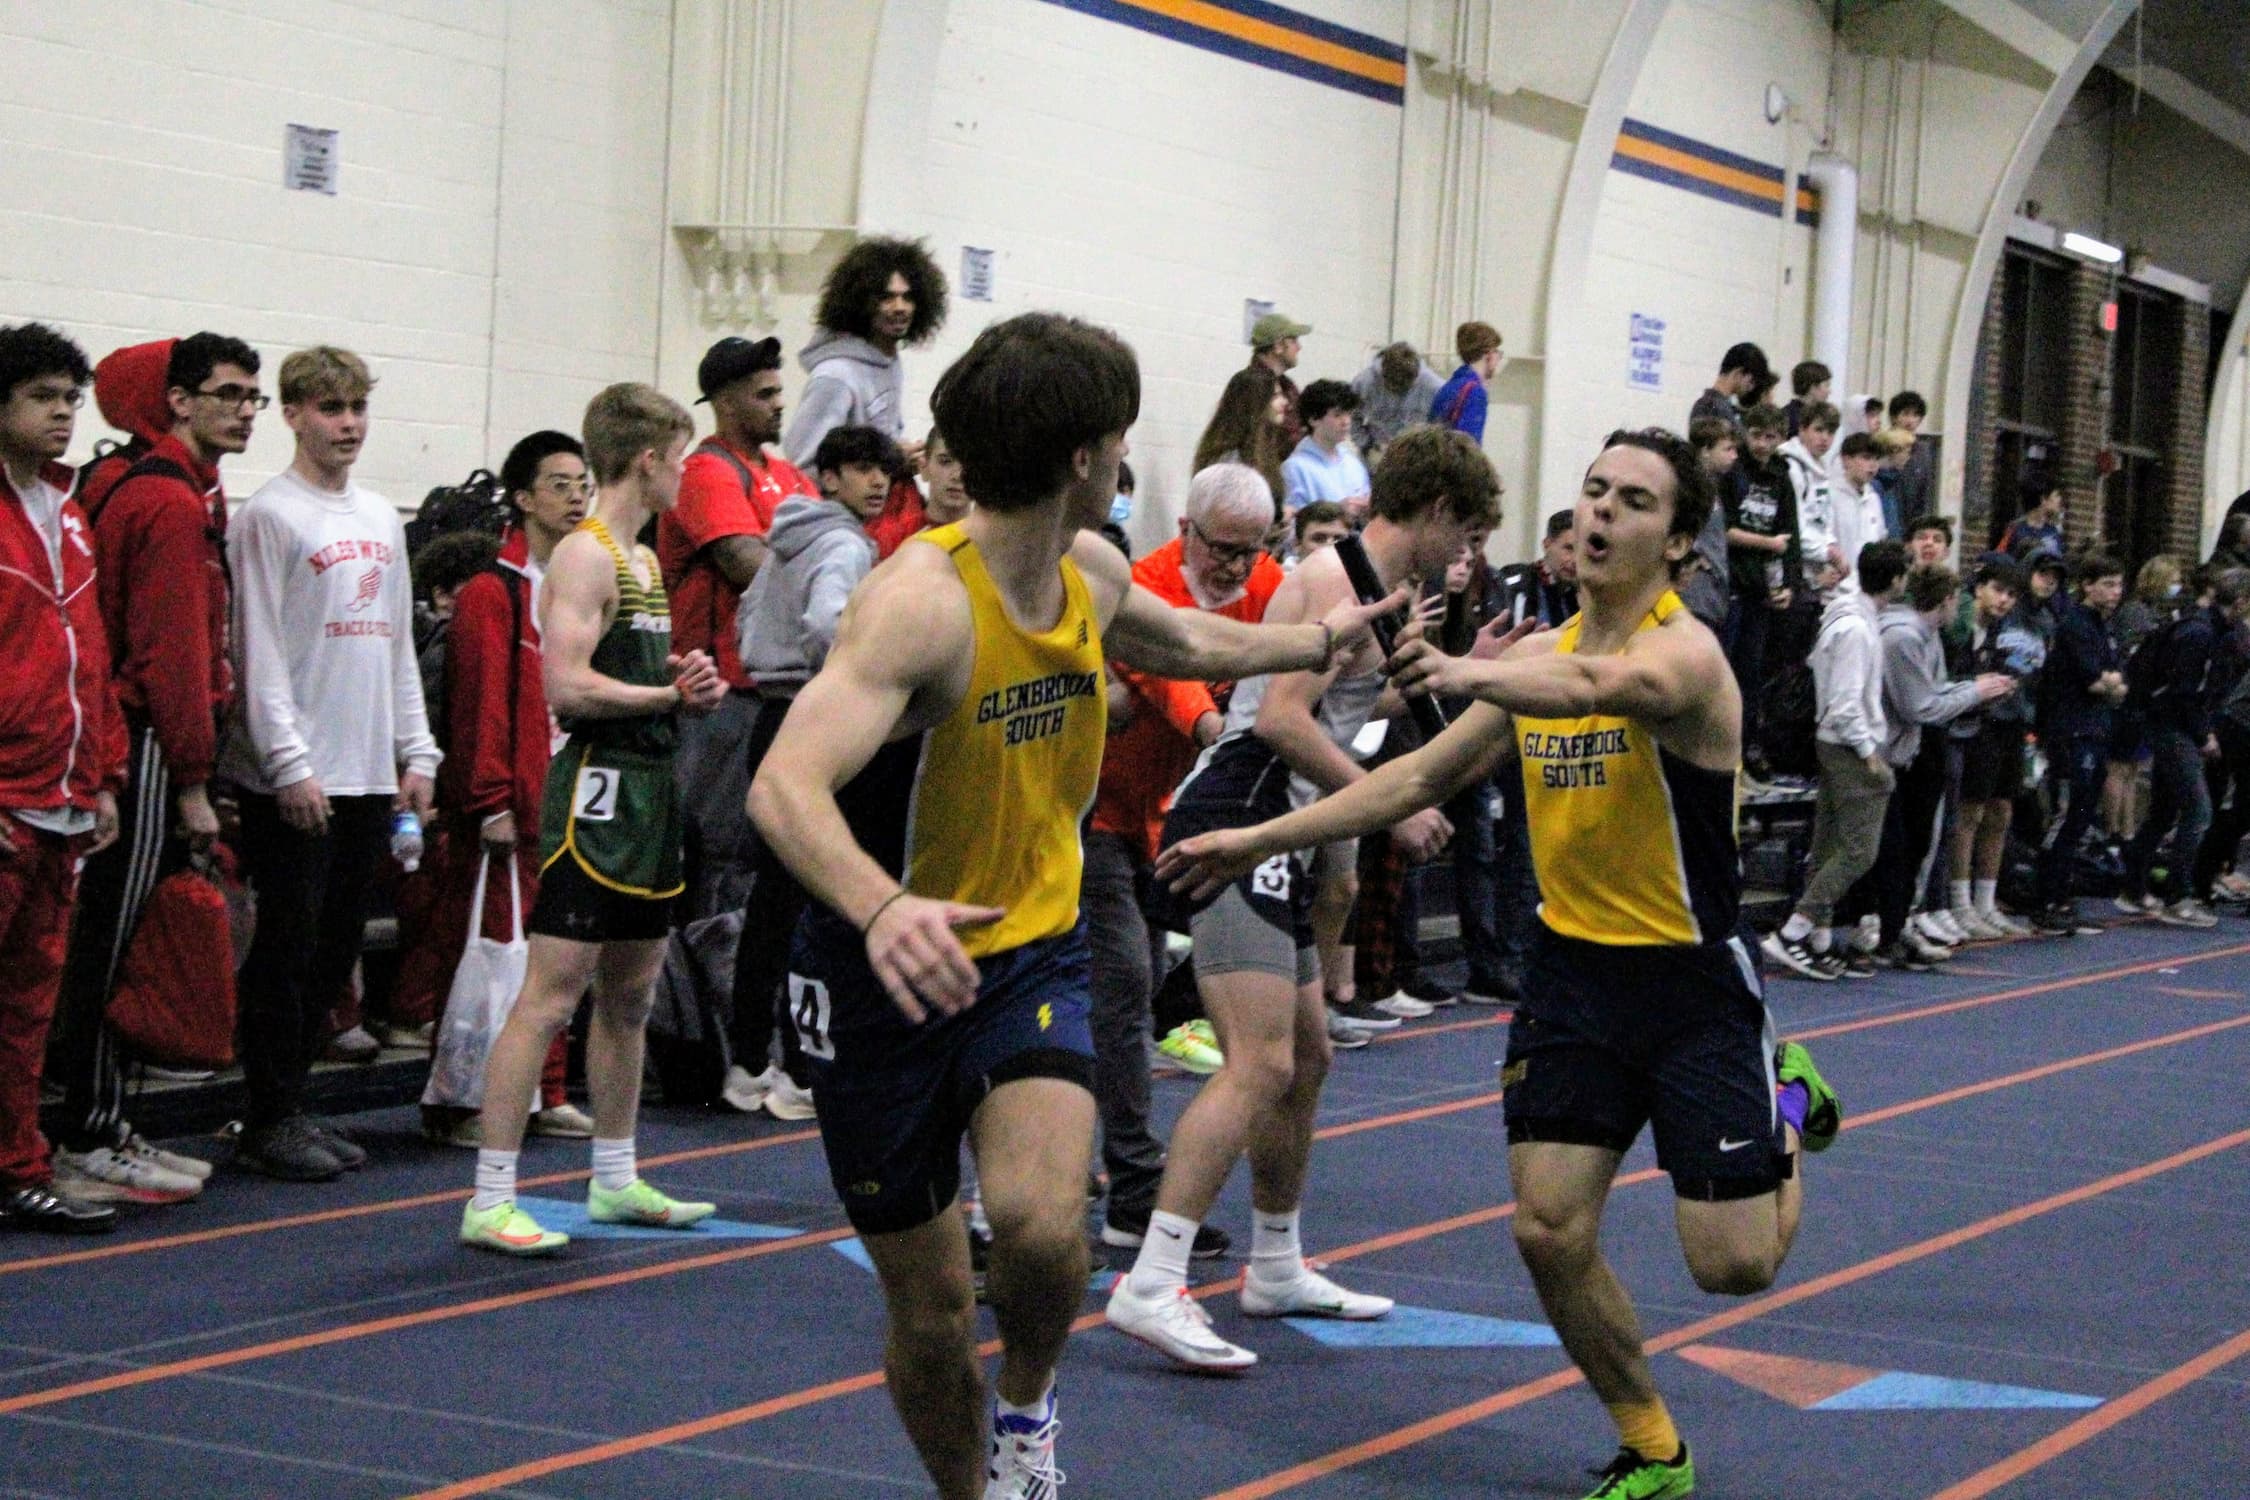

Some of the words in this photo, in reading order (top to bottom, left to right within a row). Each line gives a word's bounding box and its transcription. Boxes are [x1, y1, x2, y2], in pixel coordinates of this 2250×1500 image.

[308, 540, 357, 575] NILES
[357, 540, 395, 566] WES
[978, 672, 1097, 724] GLENBROOK
[1005, 706, 1065, 746] SOUTH
[1524, 728, 1630, 759] GLENBROOK
[583, 771, 608, 815] 2
[1543, 762, 1606, 788] SOUTH
[797, 984, 824, 1052] 4
